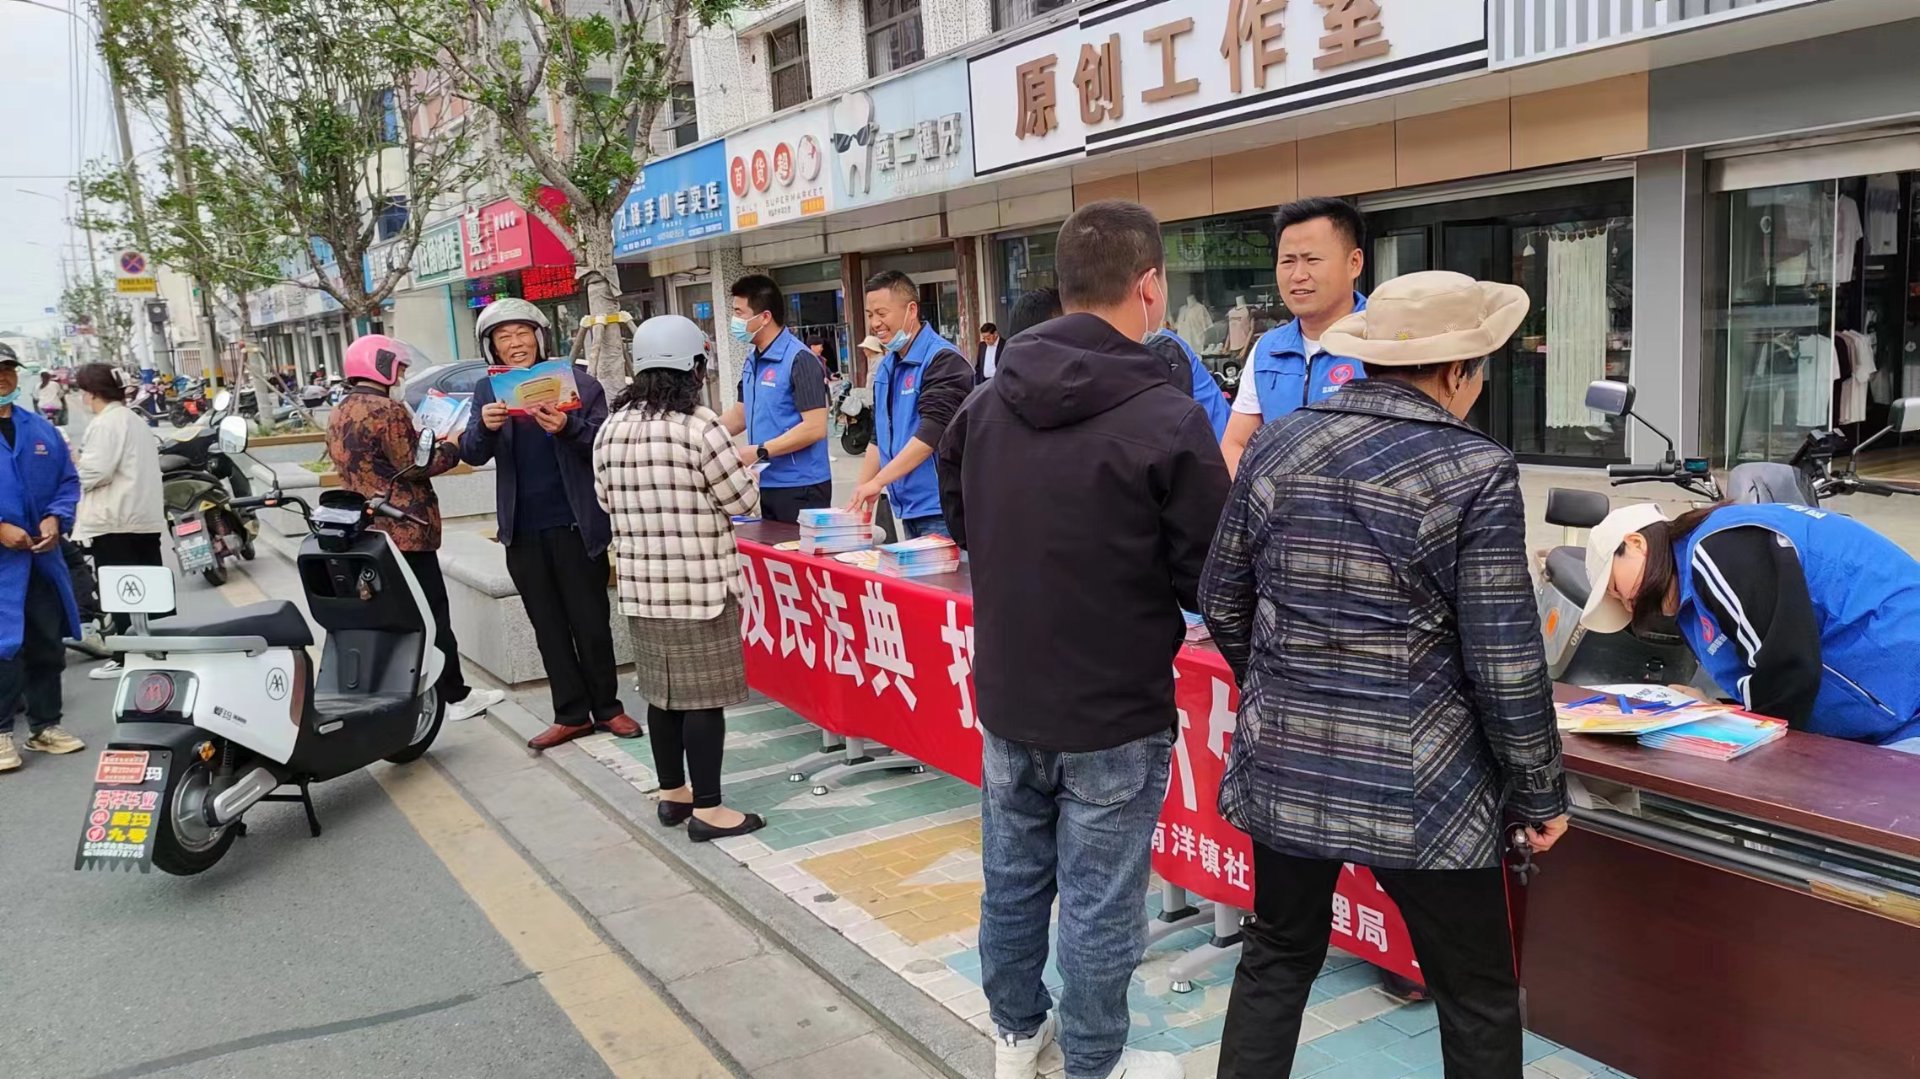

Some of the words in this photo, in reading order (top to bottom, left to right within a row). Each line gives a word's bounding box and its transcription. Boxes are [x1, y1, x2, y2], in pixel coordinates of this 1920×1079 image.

[1015, 0, 1392, 140] 原创工作室
[732, 137, 819, 192] 百货超
[765, 187, 823, 207] SUPERMARKET
[107, 827, 148, 844] 九号
